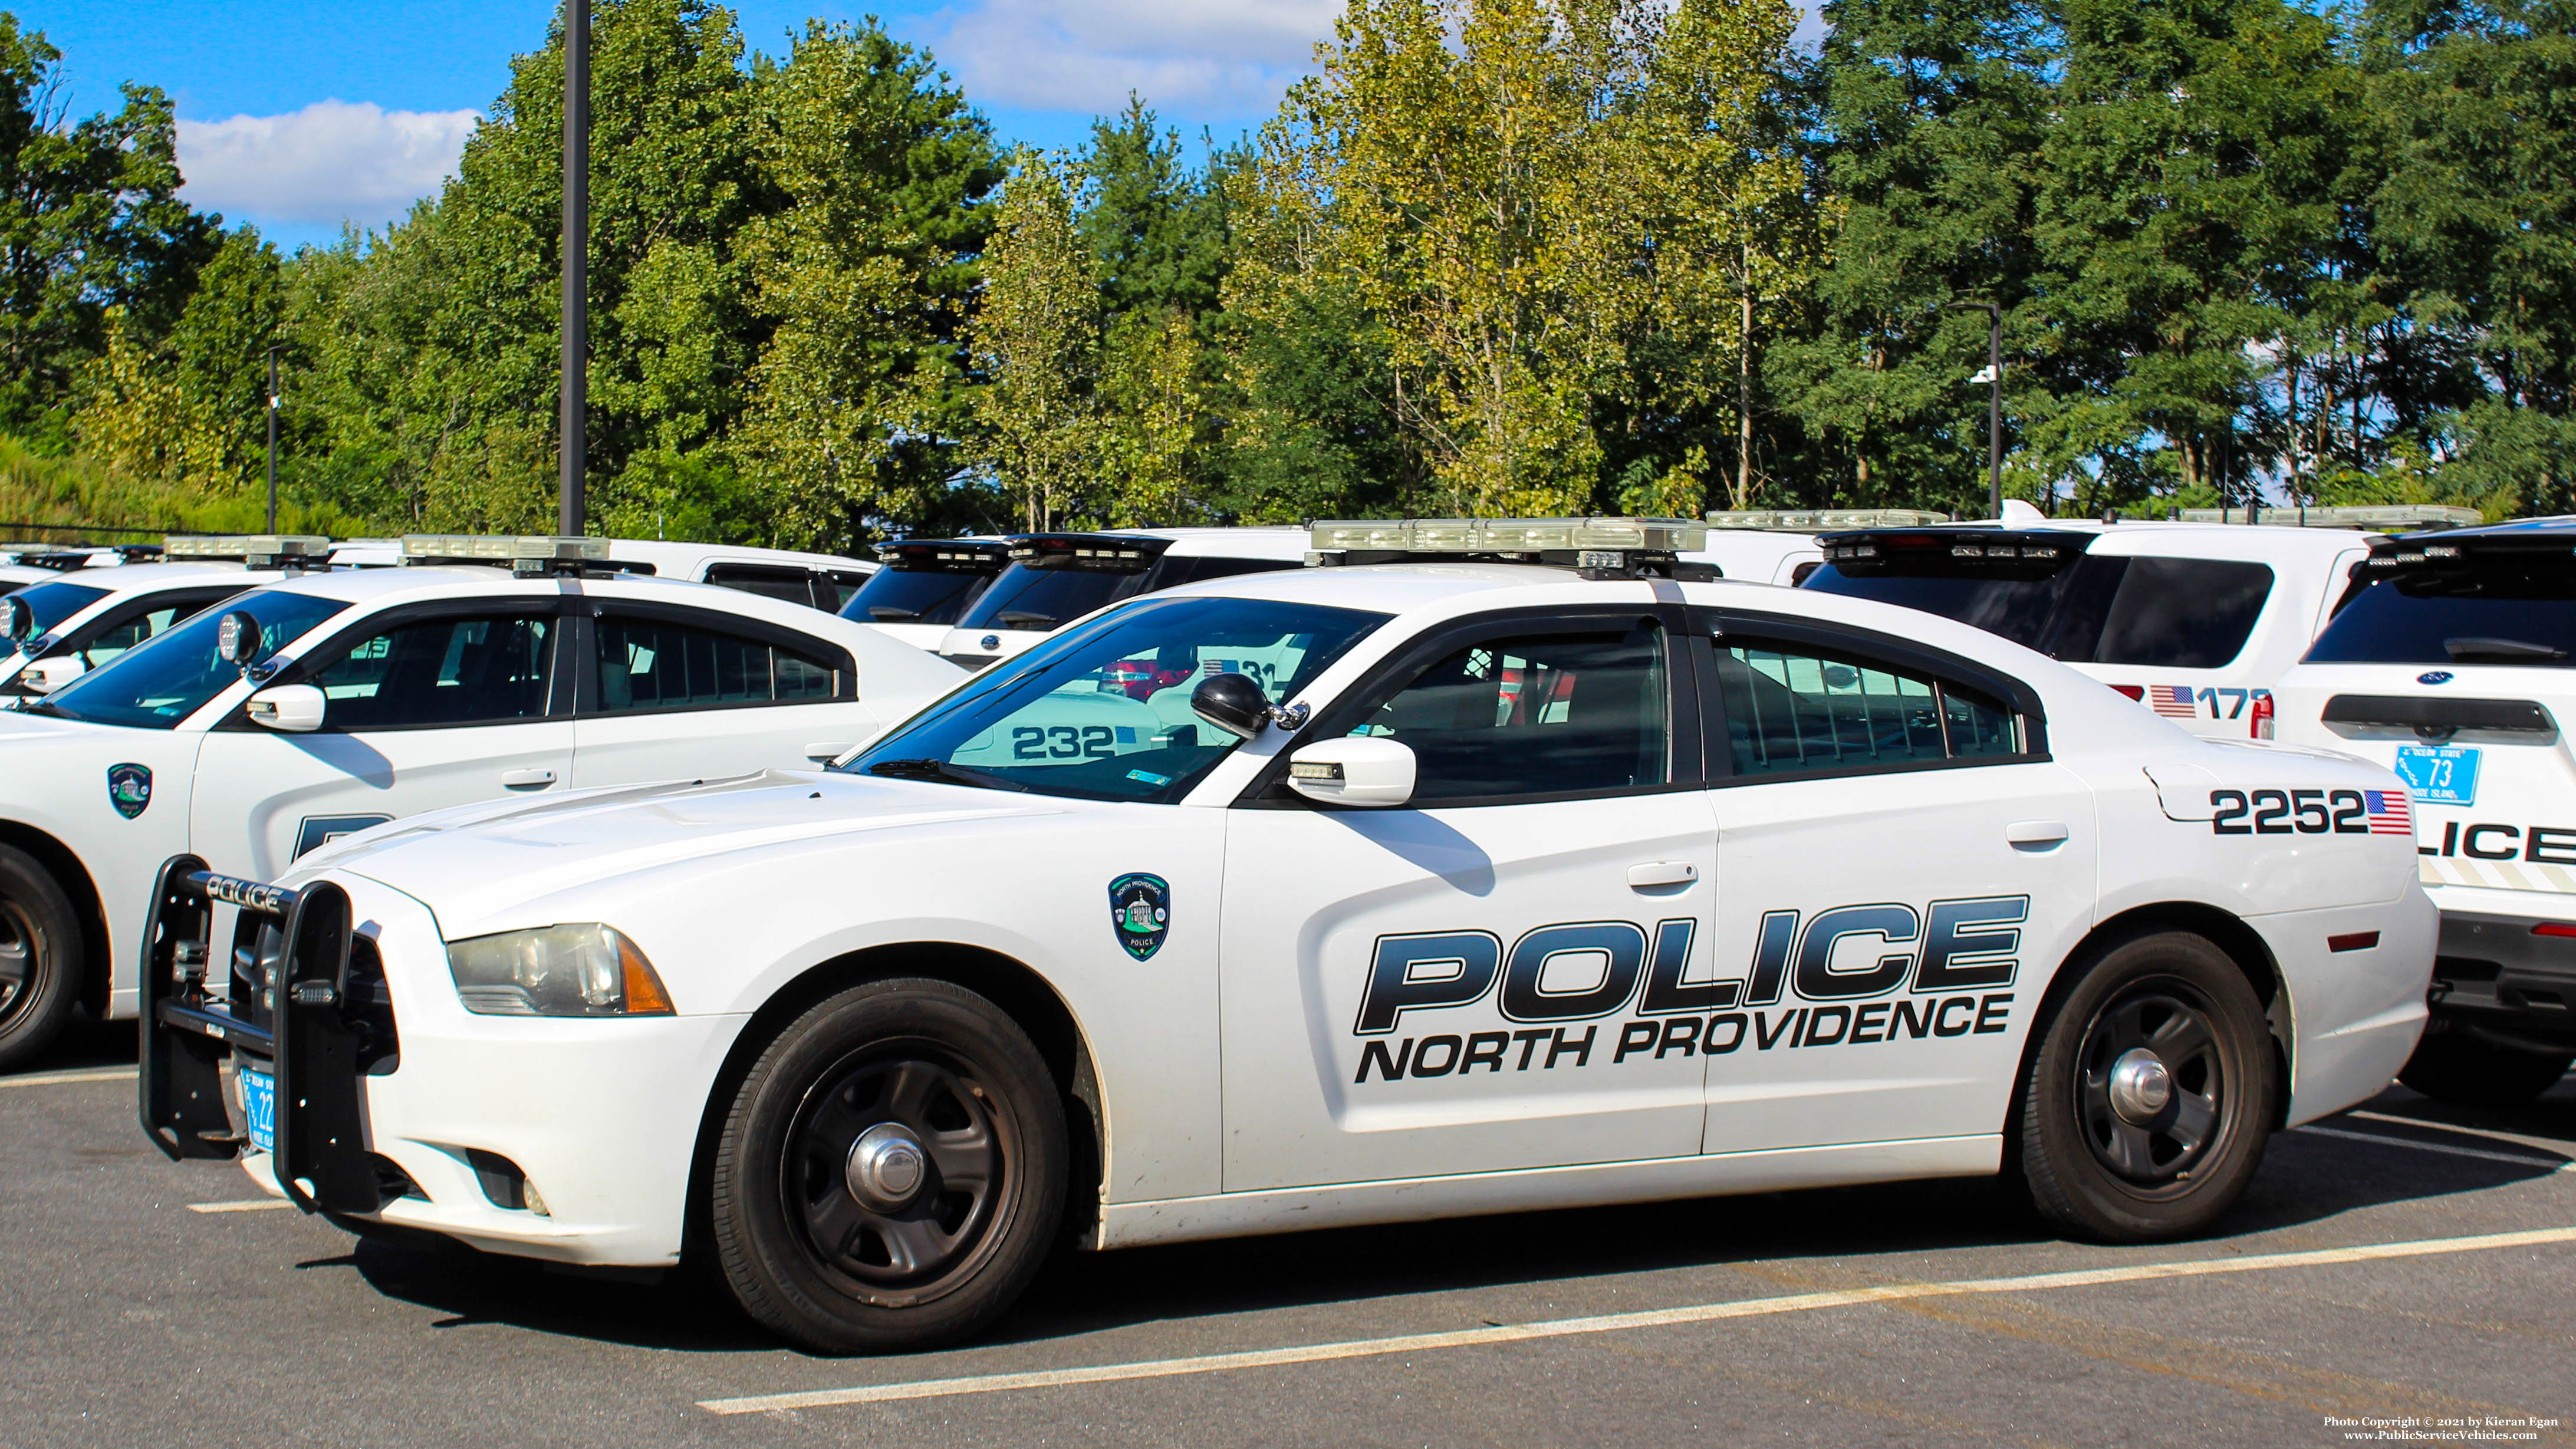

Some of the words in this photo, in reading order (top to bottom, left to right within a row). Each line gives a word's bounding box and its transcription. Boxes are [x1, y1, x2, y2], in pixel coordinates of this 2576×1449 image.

[1012, 726, 1116, 759] 232
[2429, 759, 2453, 787] 73
[2210, 789, 2369, 835] 2252
[207, 875, 285, 913] POLICE
[1116, 882, 1131, 897] NORTH
[1131, 880, 1162, 896] PROVIDENCE
[1353, 894, 2031, 1036] POLICE
[1354, 1025, 1598, 1084] NORTH
[1613, 993, 2015, 1064] PROVIDENCE
